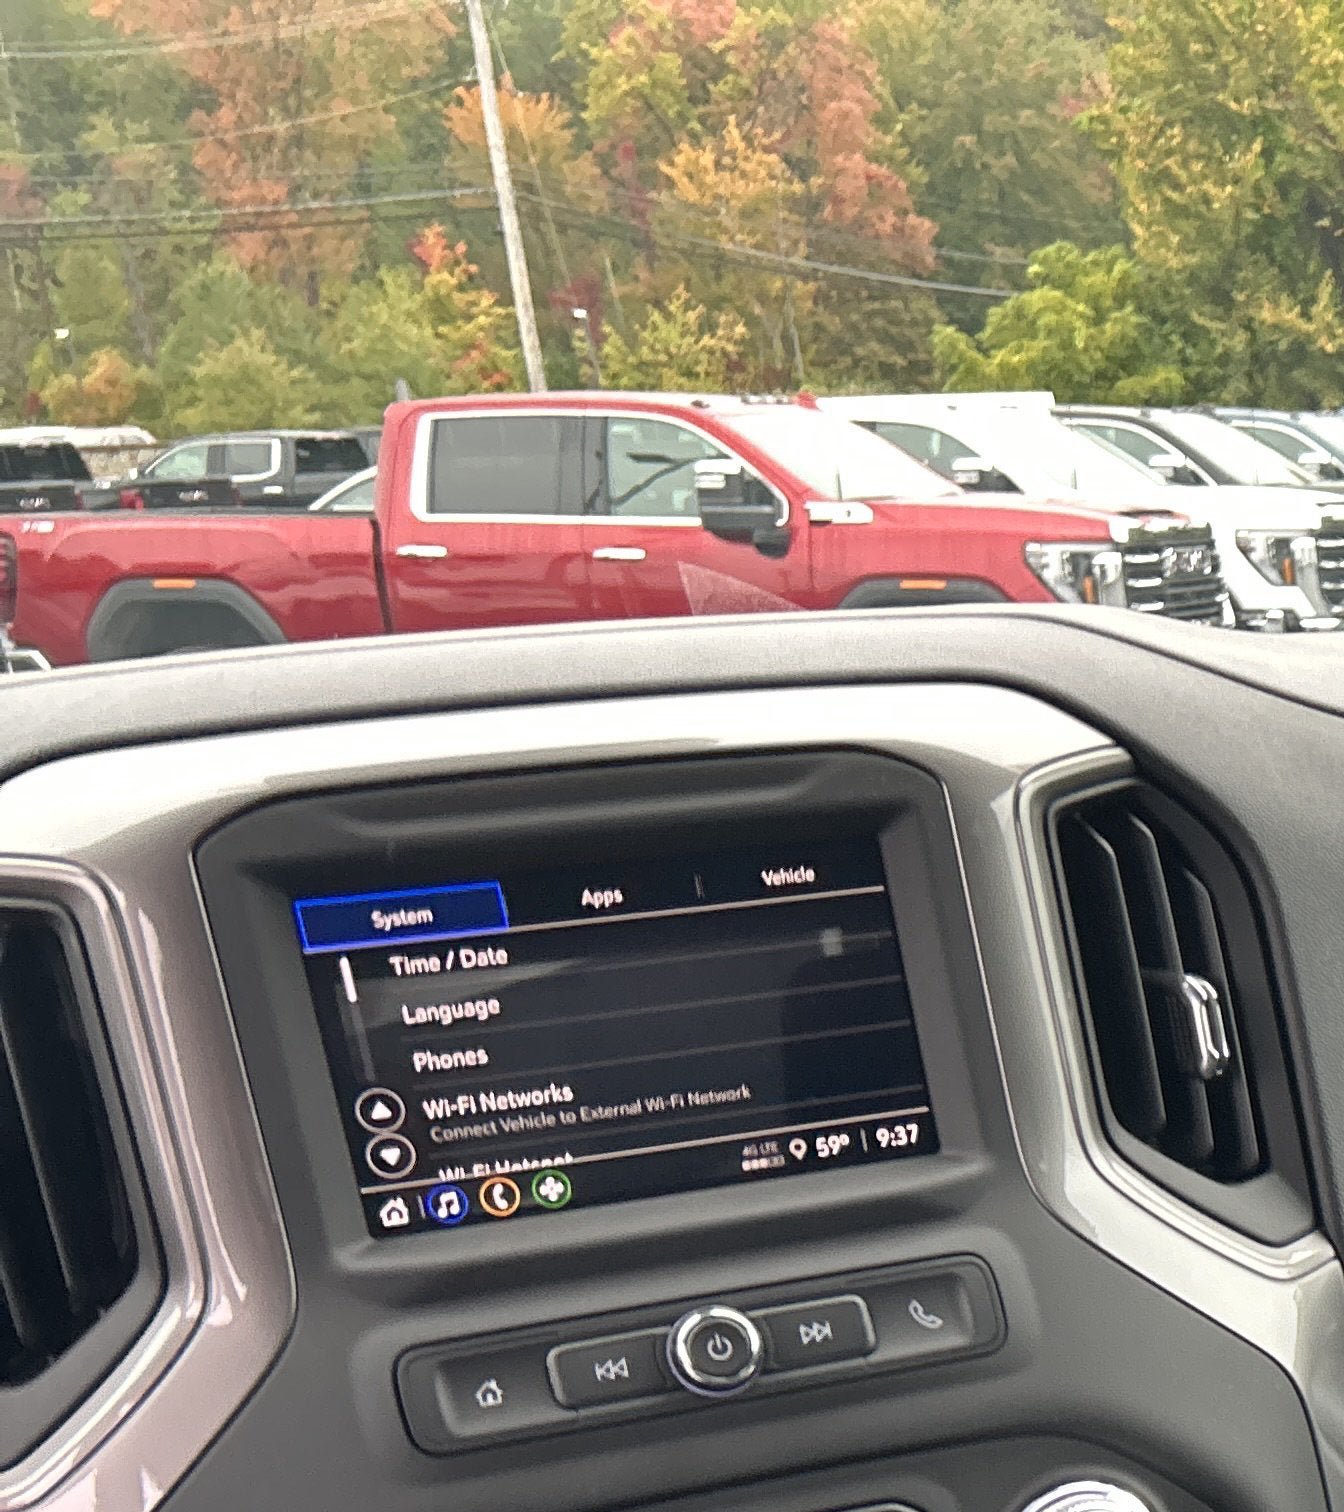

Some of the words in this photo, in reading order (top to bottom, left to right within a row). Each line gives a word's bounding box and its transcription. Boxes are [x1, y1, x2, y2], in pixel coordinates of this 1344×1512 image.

[760, 864, 816, 888] Vehicle
[581, 886, 623, 910] Apps
[370, 907, 434, 932] System
[389, 953, 441, 977] Time
[459, 947, 508, 970] Date
[401, 998, 501, 1026] Language
[412, 1048, 489, 1073] Phones
[423, 1094, 477, 1121] Wi-Fi
[480, 1083, 574, 1113] Networks
[429, 1119, 499, 1144] Connect
[499, 1106, 557, 1133] Vehicle
[559, 1110, 576, 1126] to
[580, 1100, 642, 1123] External
[644, 1090, 685, 1112] Wi-Fi
[688, 1083, 752, 1107] Network
[875, 1123, 919, 1149] 9:37
